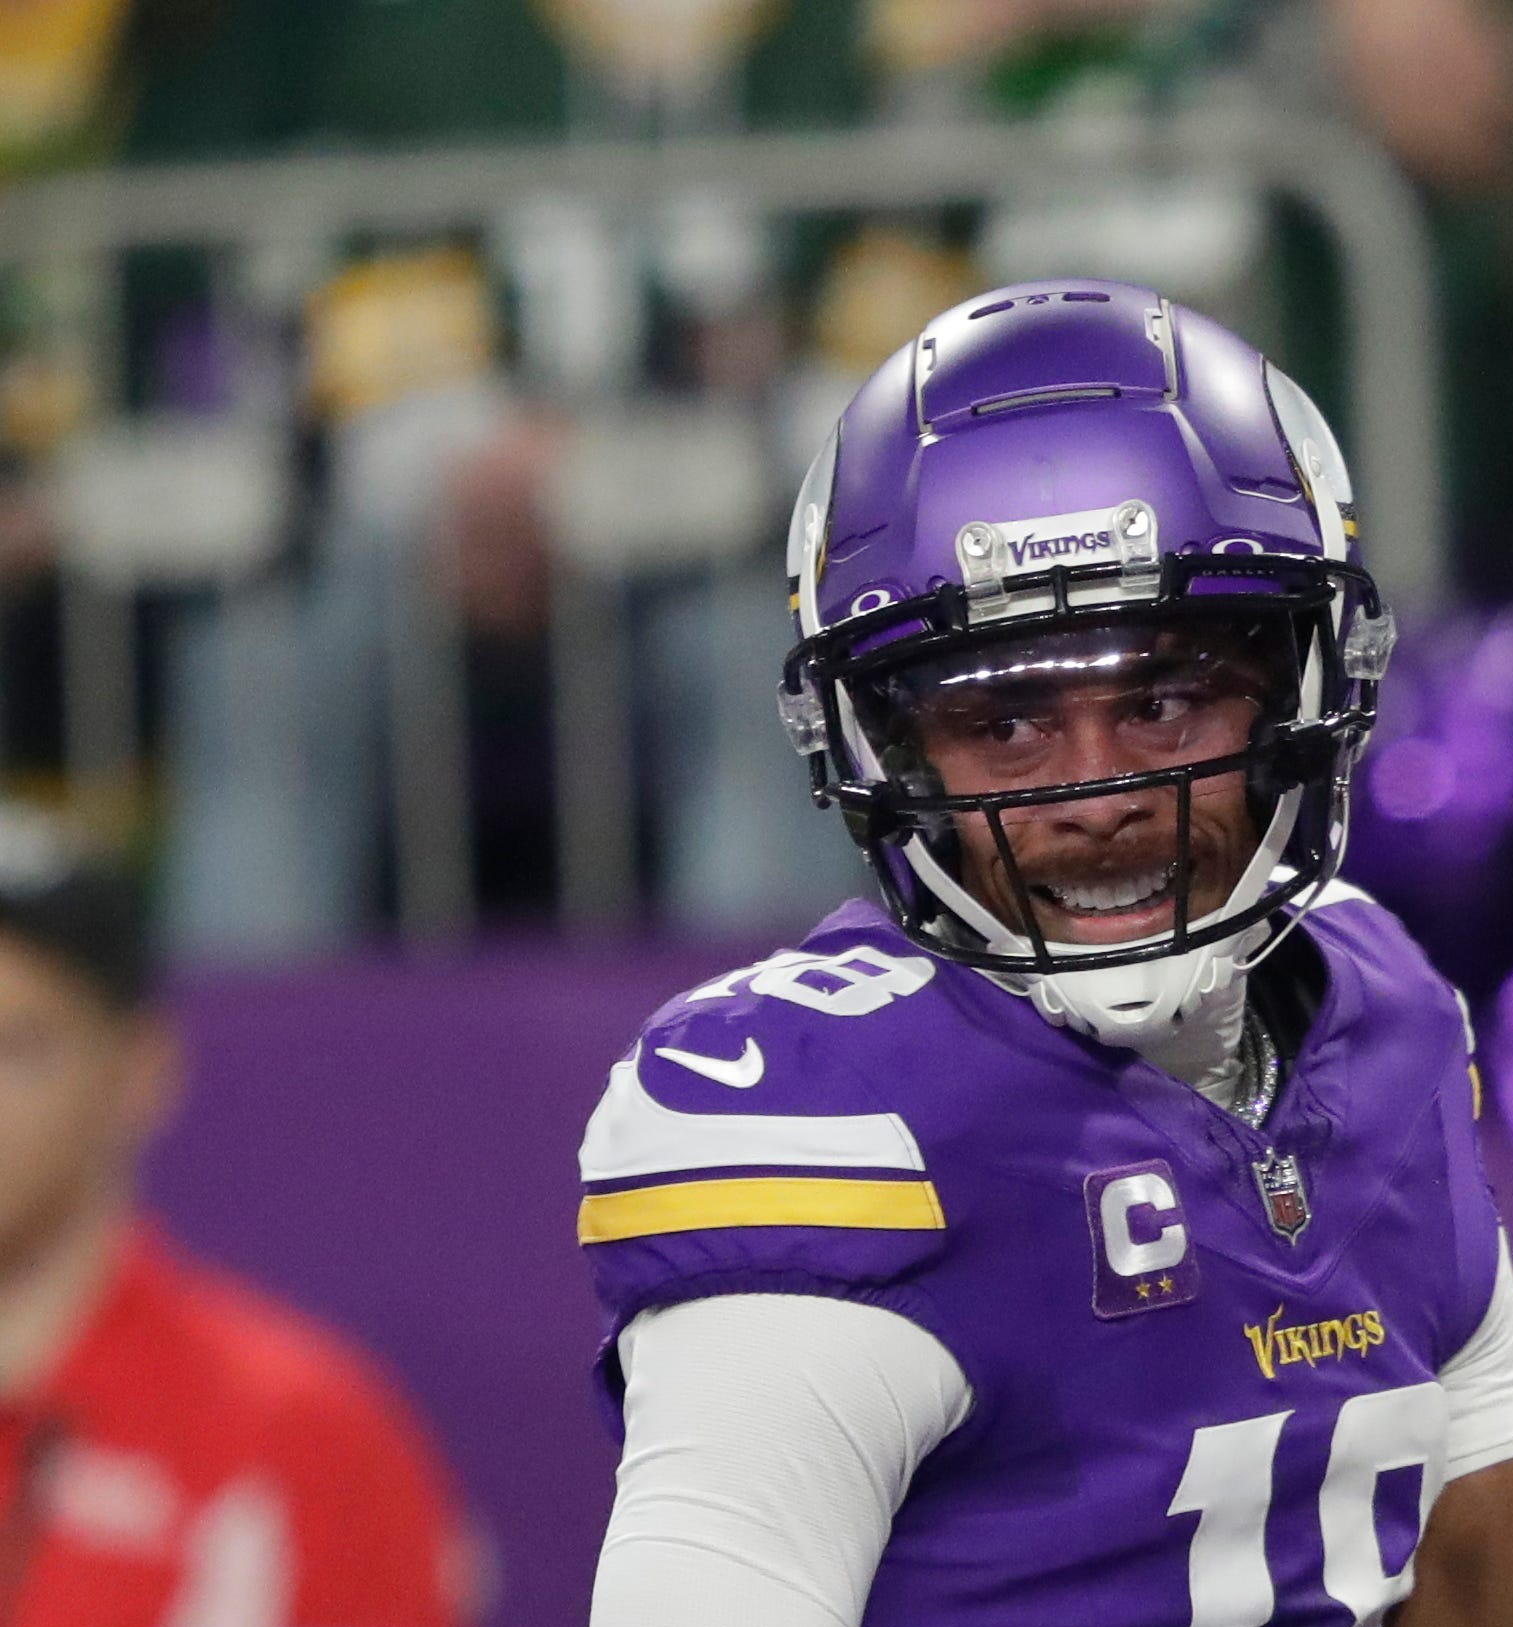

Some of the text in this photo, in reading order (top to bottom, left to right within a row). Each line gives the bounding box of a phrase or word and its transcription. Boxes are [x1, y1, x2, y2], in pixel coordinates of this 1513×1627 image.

[1008, 530, 1112, 567] VIKINGS
[1101, 1173, 1187, 1277] C
[1244, 1302, 1385, 1380] VIKINGS
